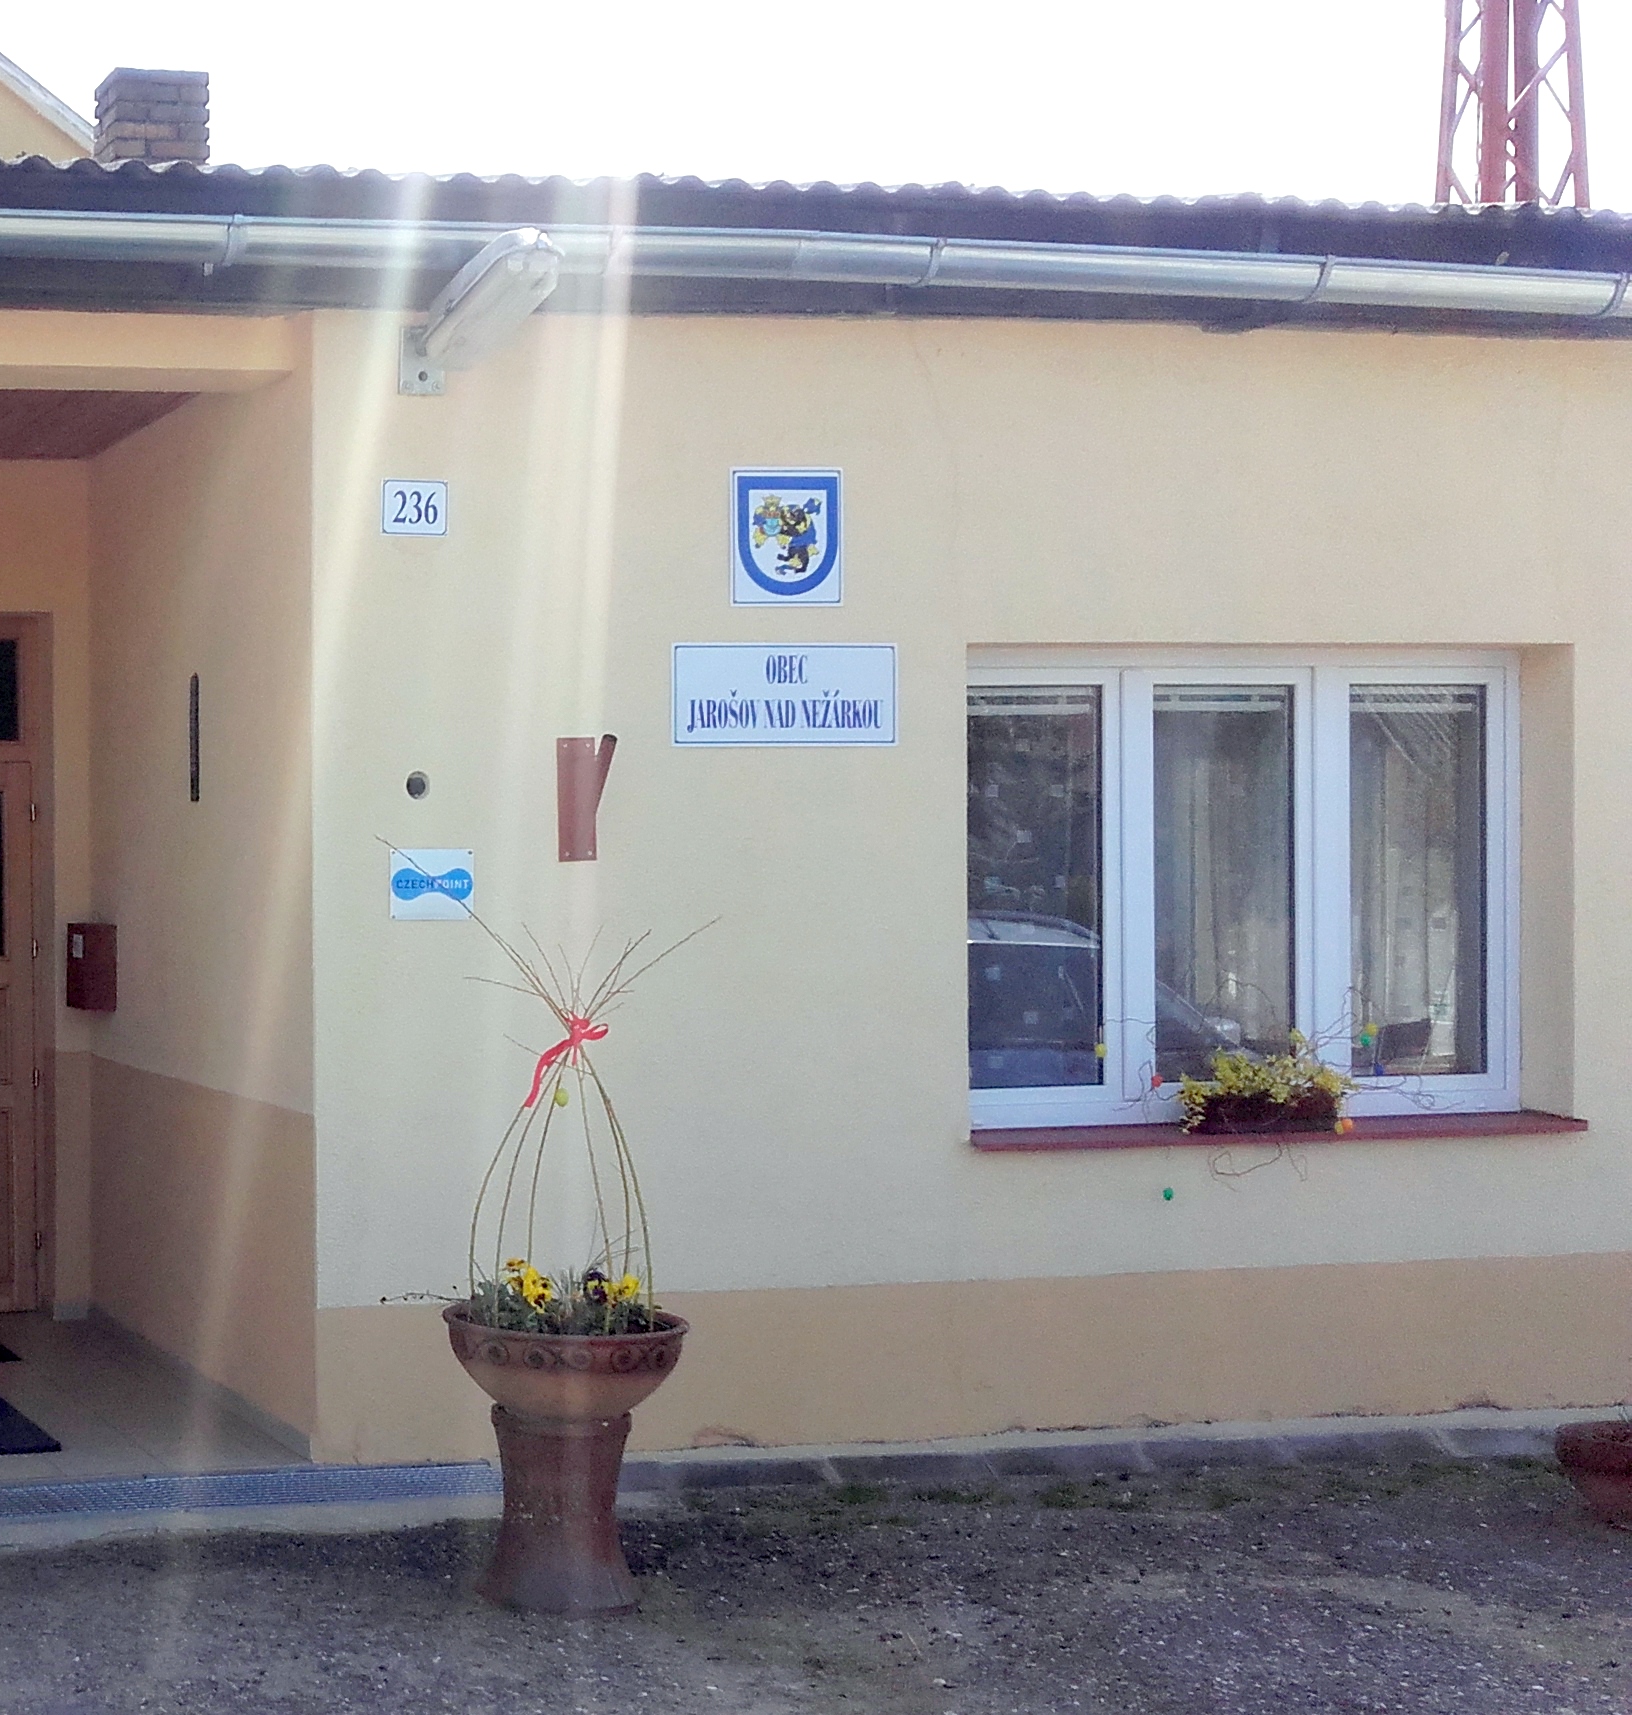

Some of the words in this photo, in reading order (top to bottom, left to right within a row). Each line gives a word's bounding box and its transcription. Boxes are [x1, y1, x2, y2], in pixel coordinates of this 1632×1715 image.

[392, 490, 438, 524] 236
[766, 655, 808, 684] OBEC
[687, 689, 759, 733] JAROŠOV
[764, 699, 796, 729] NAD
[800, 689, 883, 729] NEŽÁRKOU
